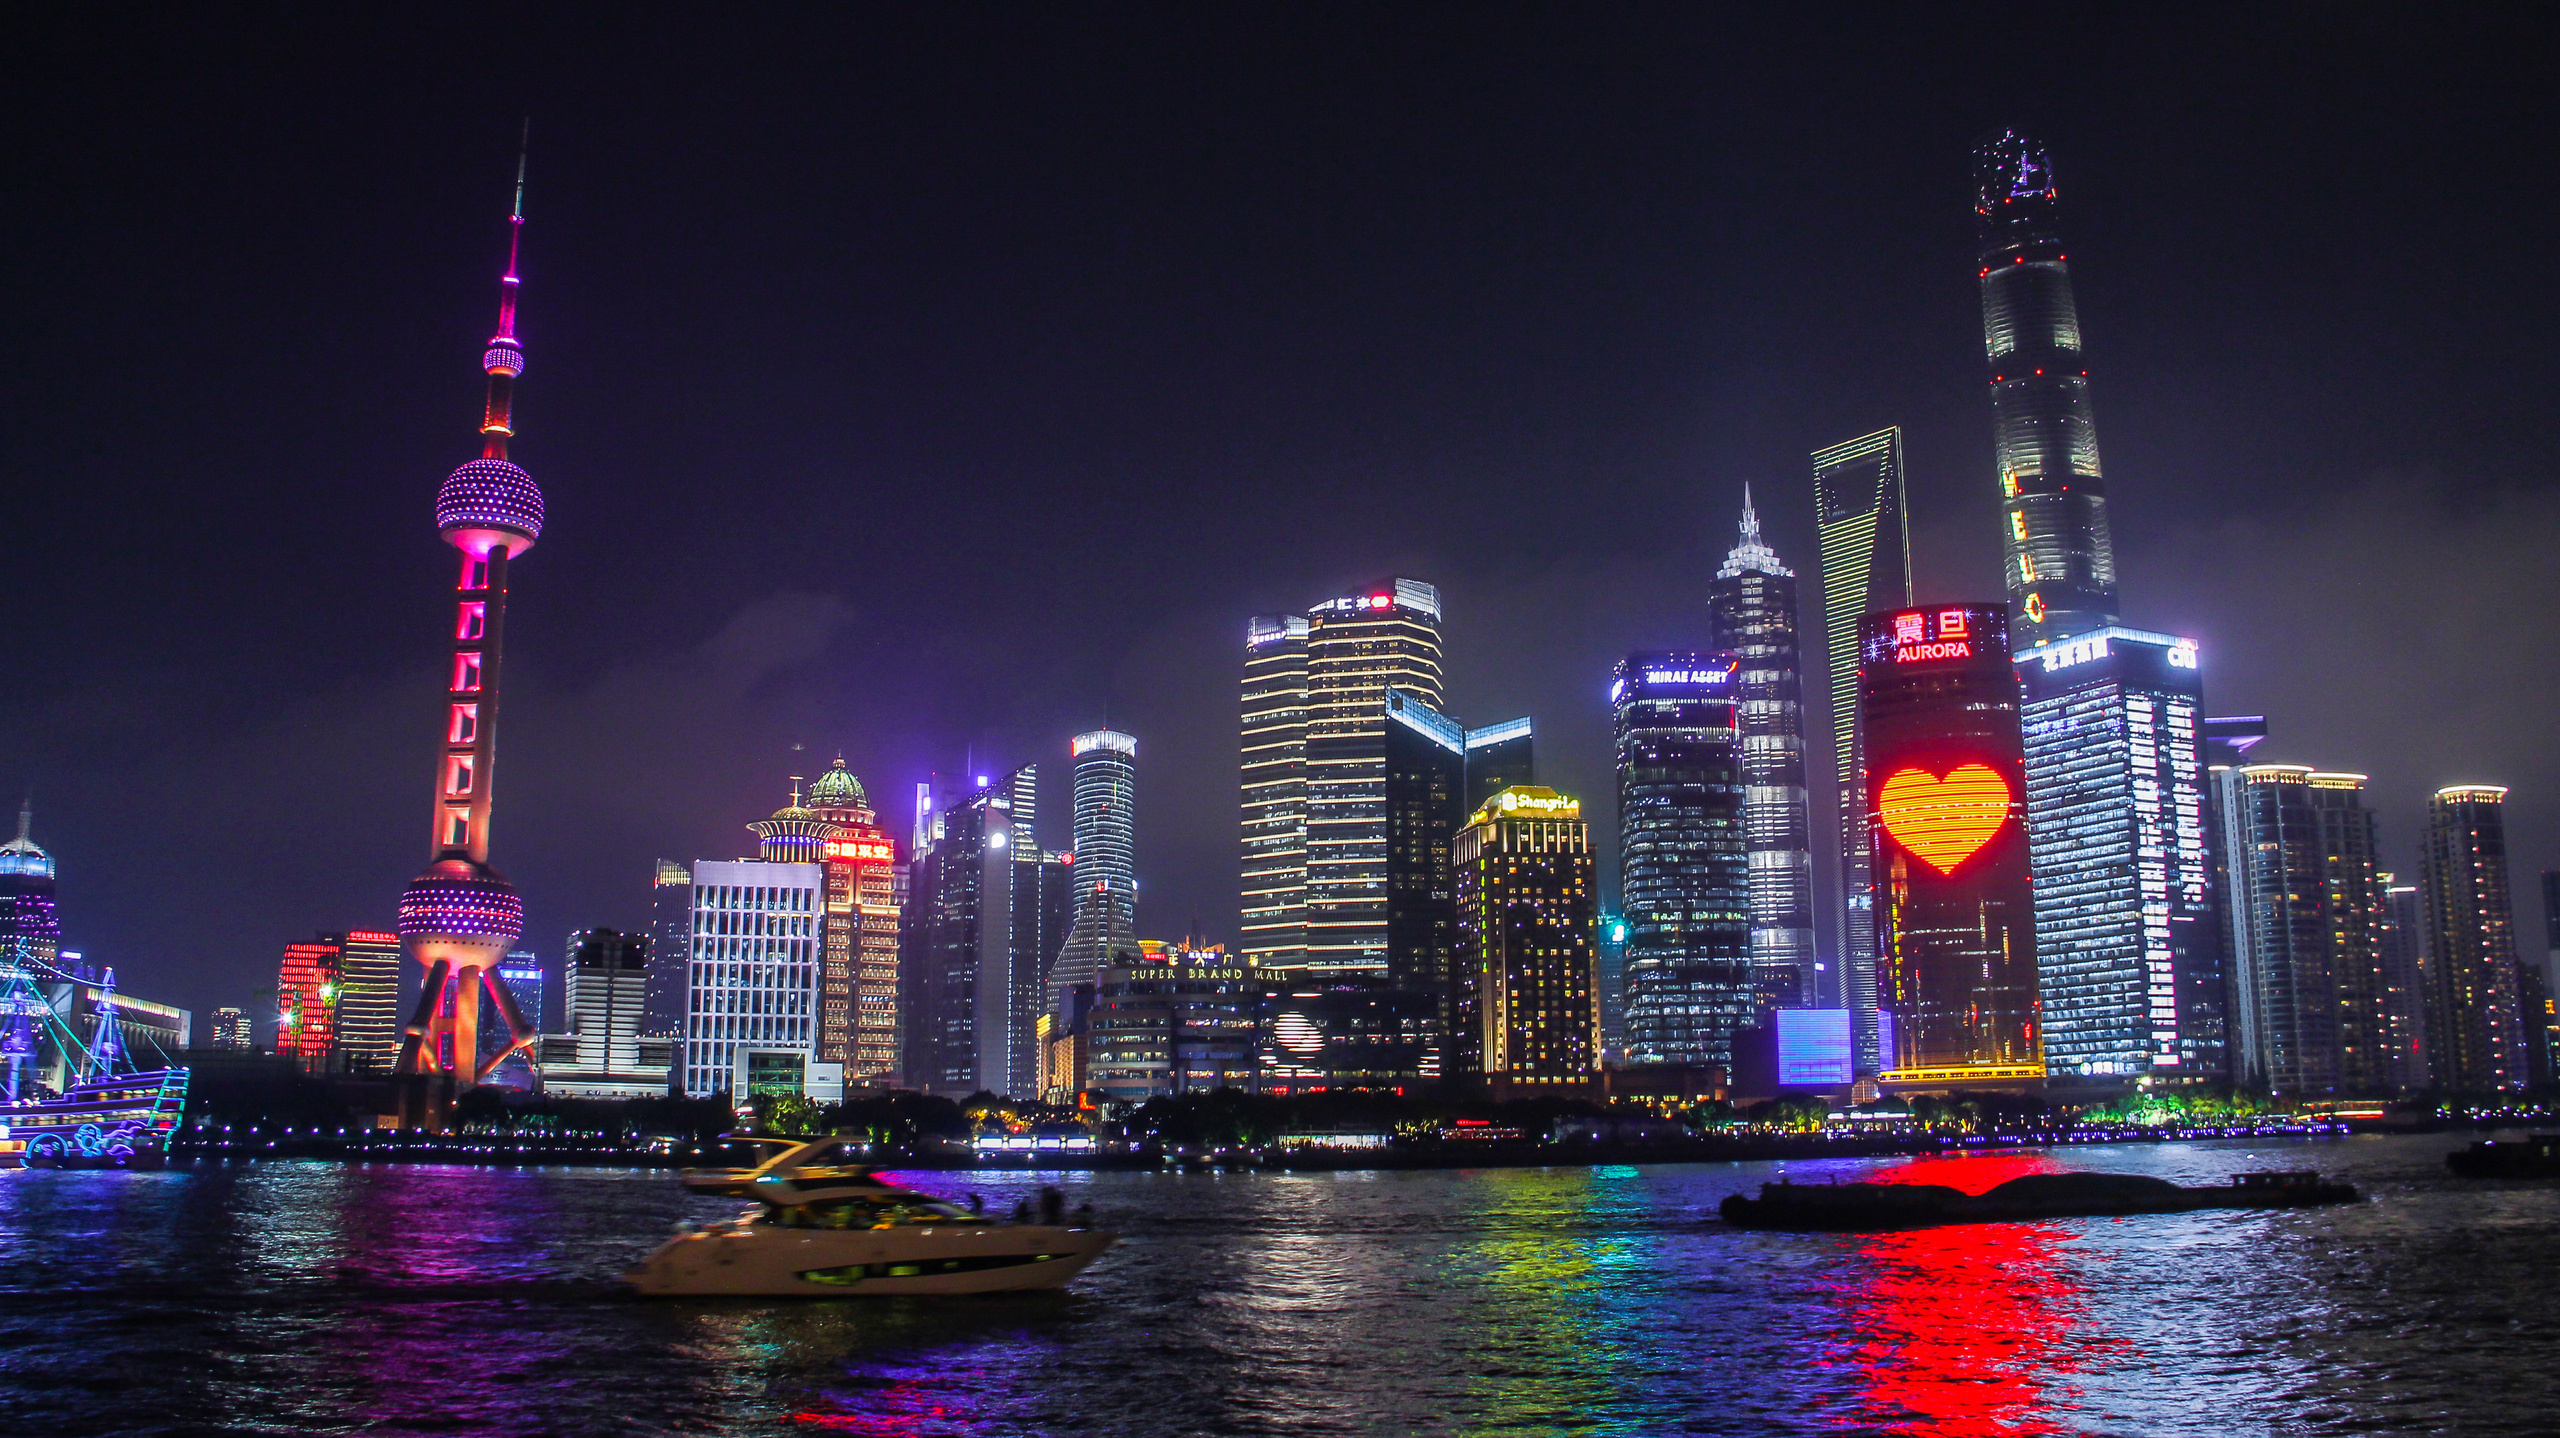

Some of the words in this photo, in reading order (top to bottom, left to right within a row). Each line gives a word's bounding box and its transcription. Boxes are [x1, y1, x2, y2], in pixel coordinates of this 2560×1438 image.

[1895, 611, 1968, 644] 震旦
[1896, 642, 1970, 663] AURORA
[1647, 671, 1689, 684] MIRAE
[1690, 670, 1729, 683] ASSET
[1517, 794, 1579, 812] Shangri-La
[825, 842, 889, 859] 中国平安
[1131, 969, 1175, 980] SUPER
[1188, 968, 1242, 980] BRAND
[1254, 970, 1288, 981] MALL
